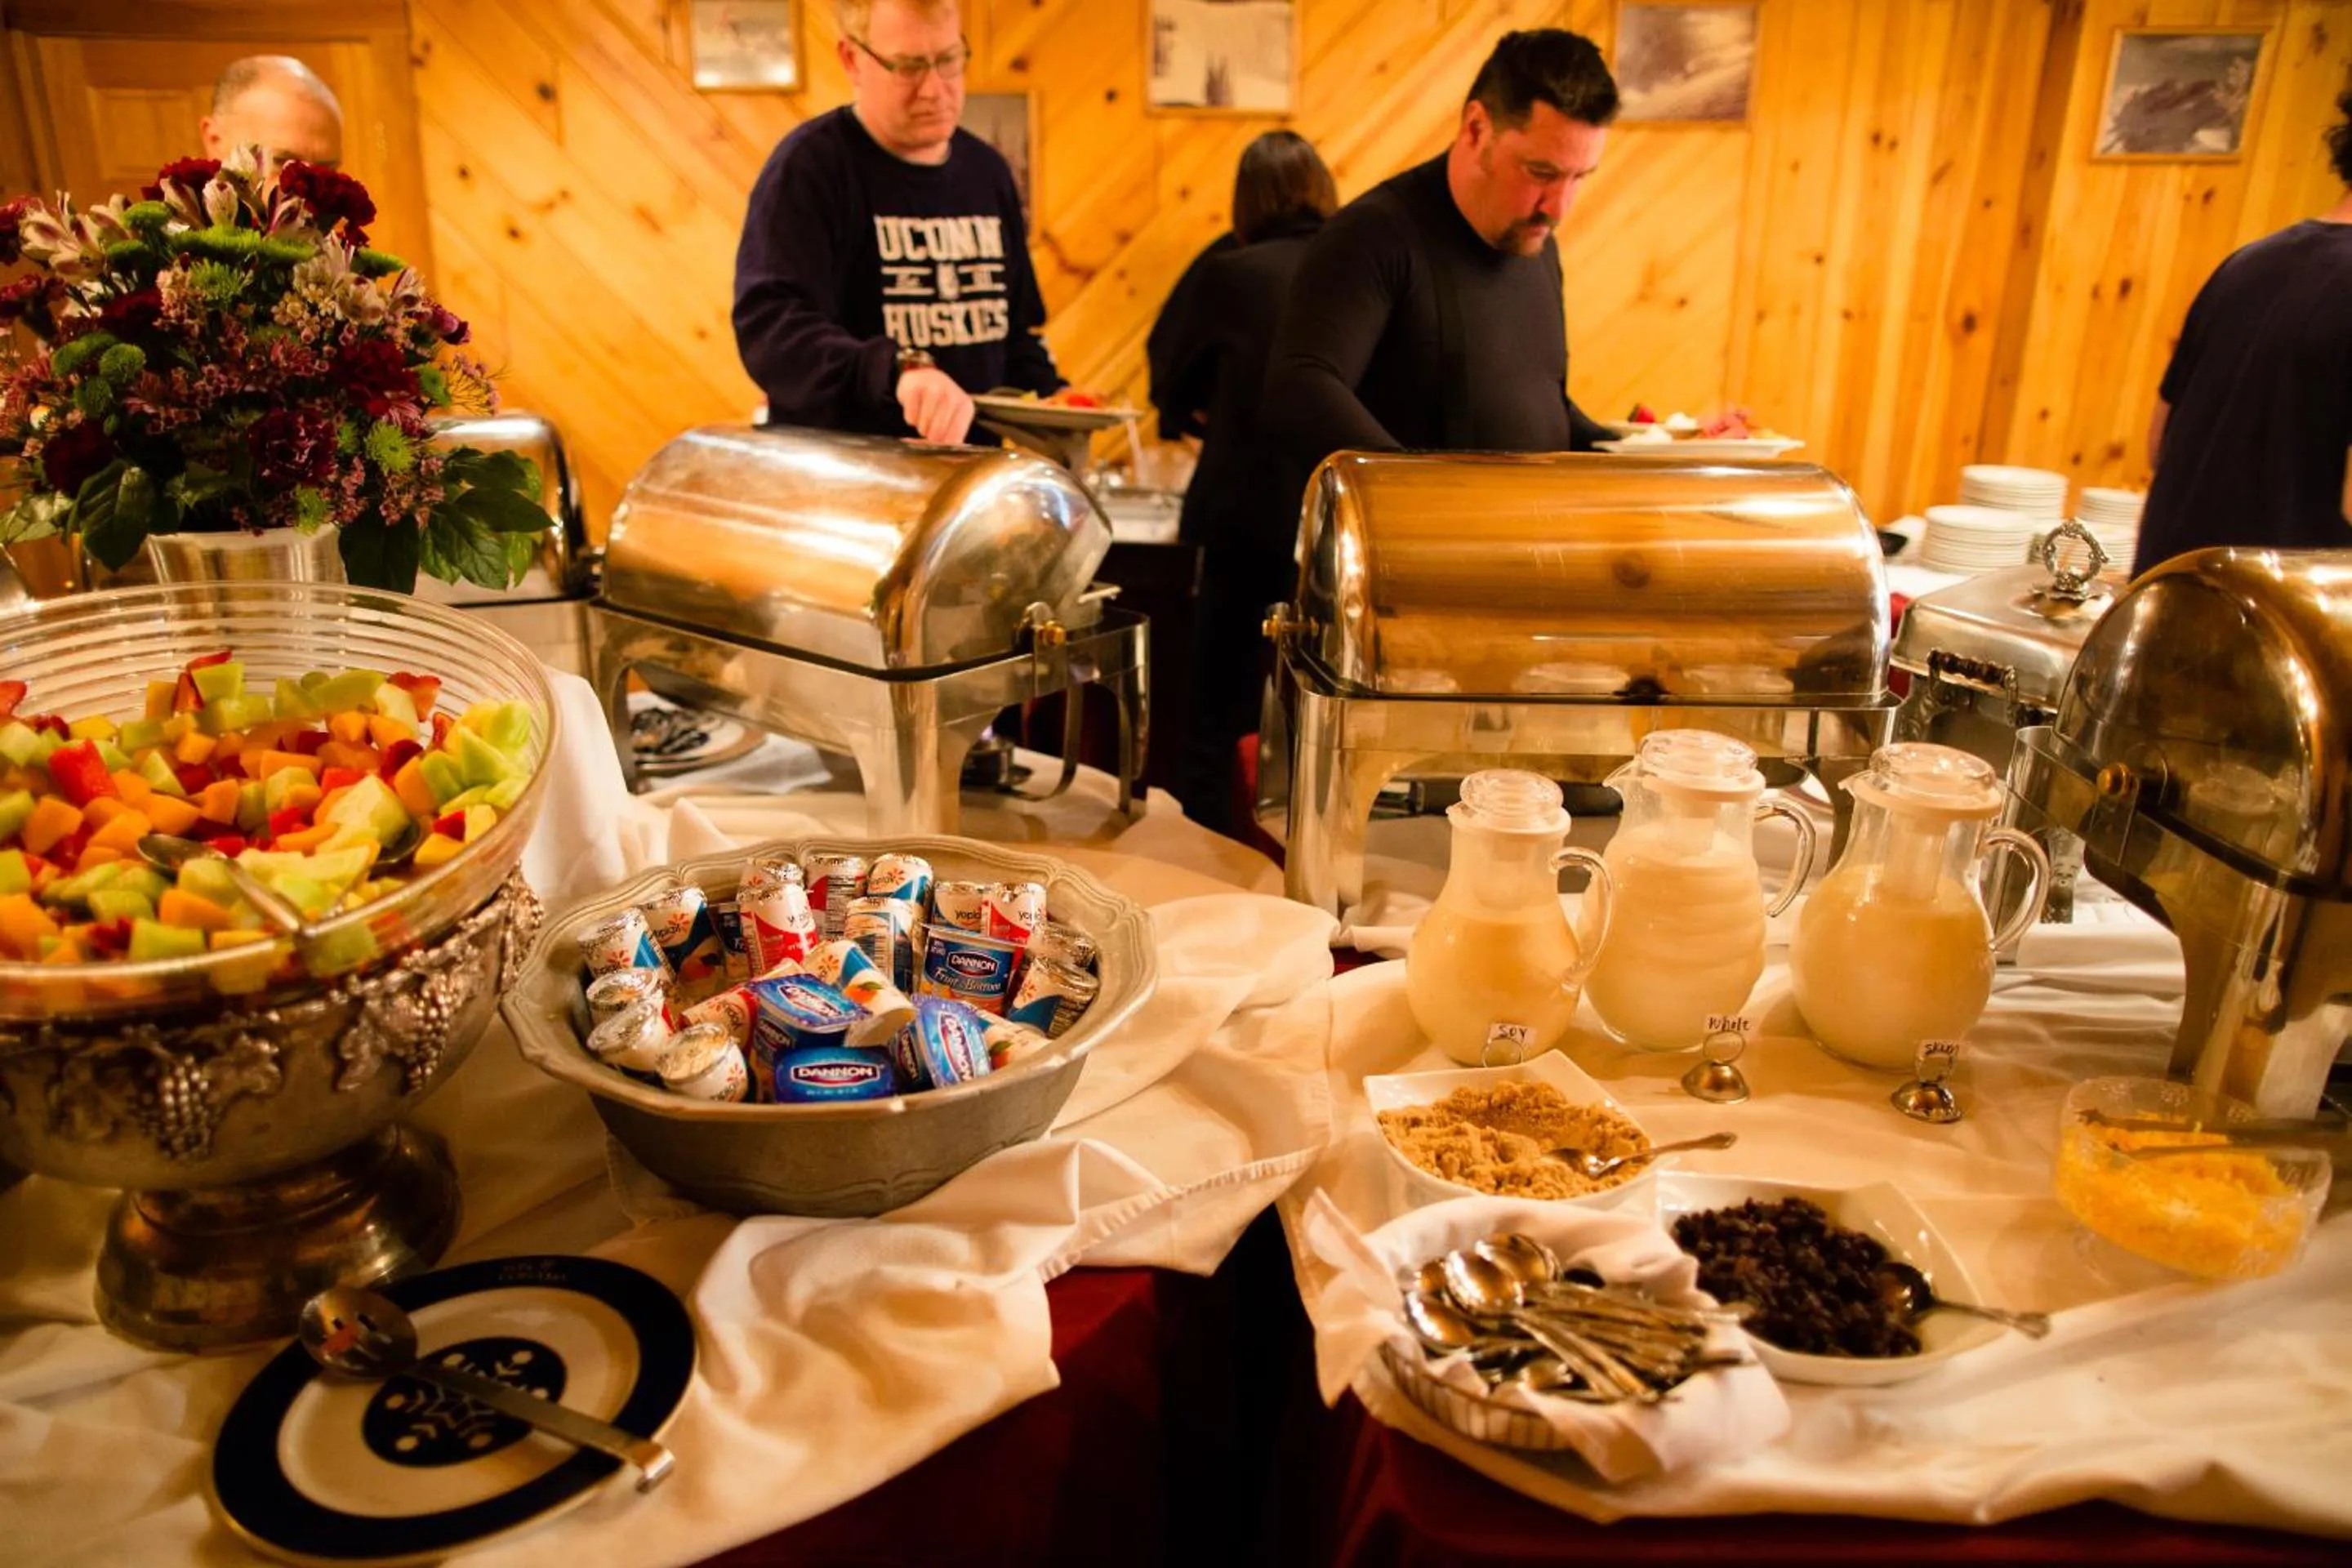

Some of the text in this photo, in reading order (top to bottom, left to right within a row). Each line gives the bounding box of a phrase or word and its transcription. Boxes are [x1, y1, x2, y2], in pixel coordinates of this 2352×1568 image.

[874, 216, 1004, 261] UCONN
[883, 298, 1009, 348] HUSKIES
[951, 955, 995, 971] DANNON
[797, 1067, 873, 1077] DANNON
